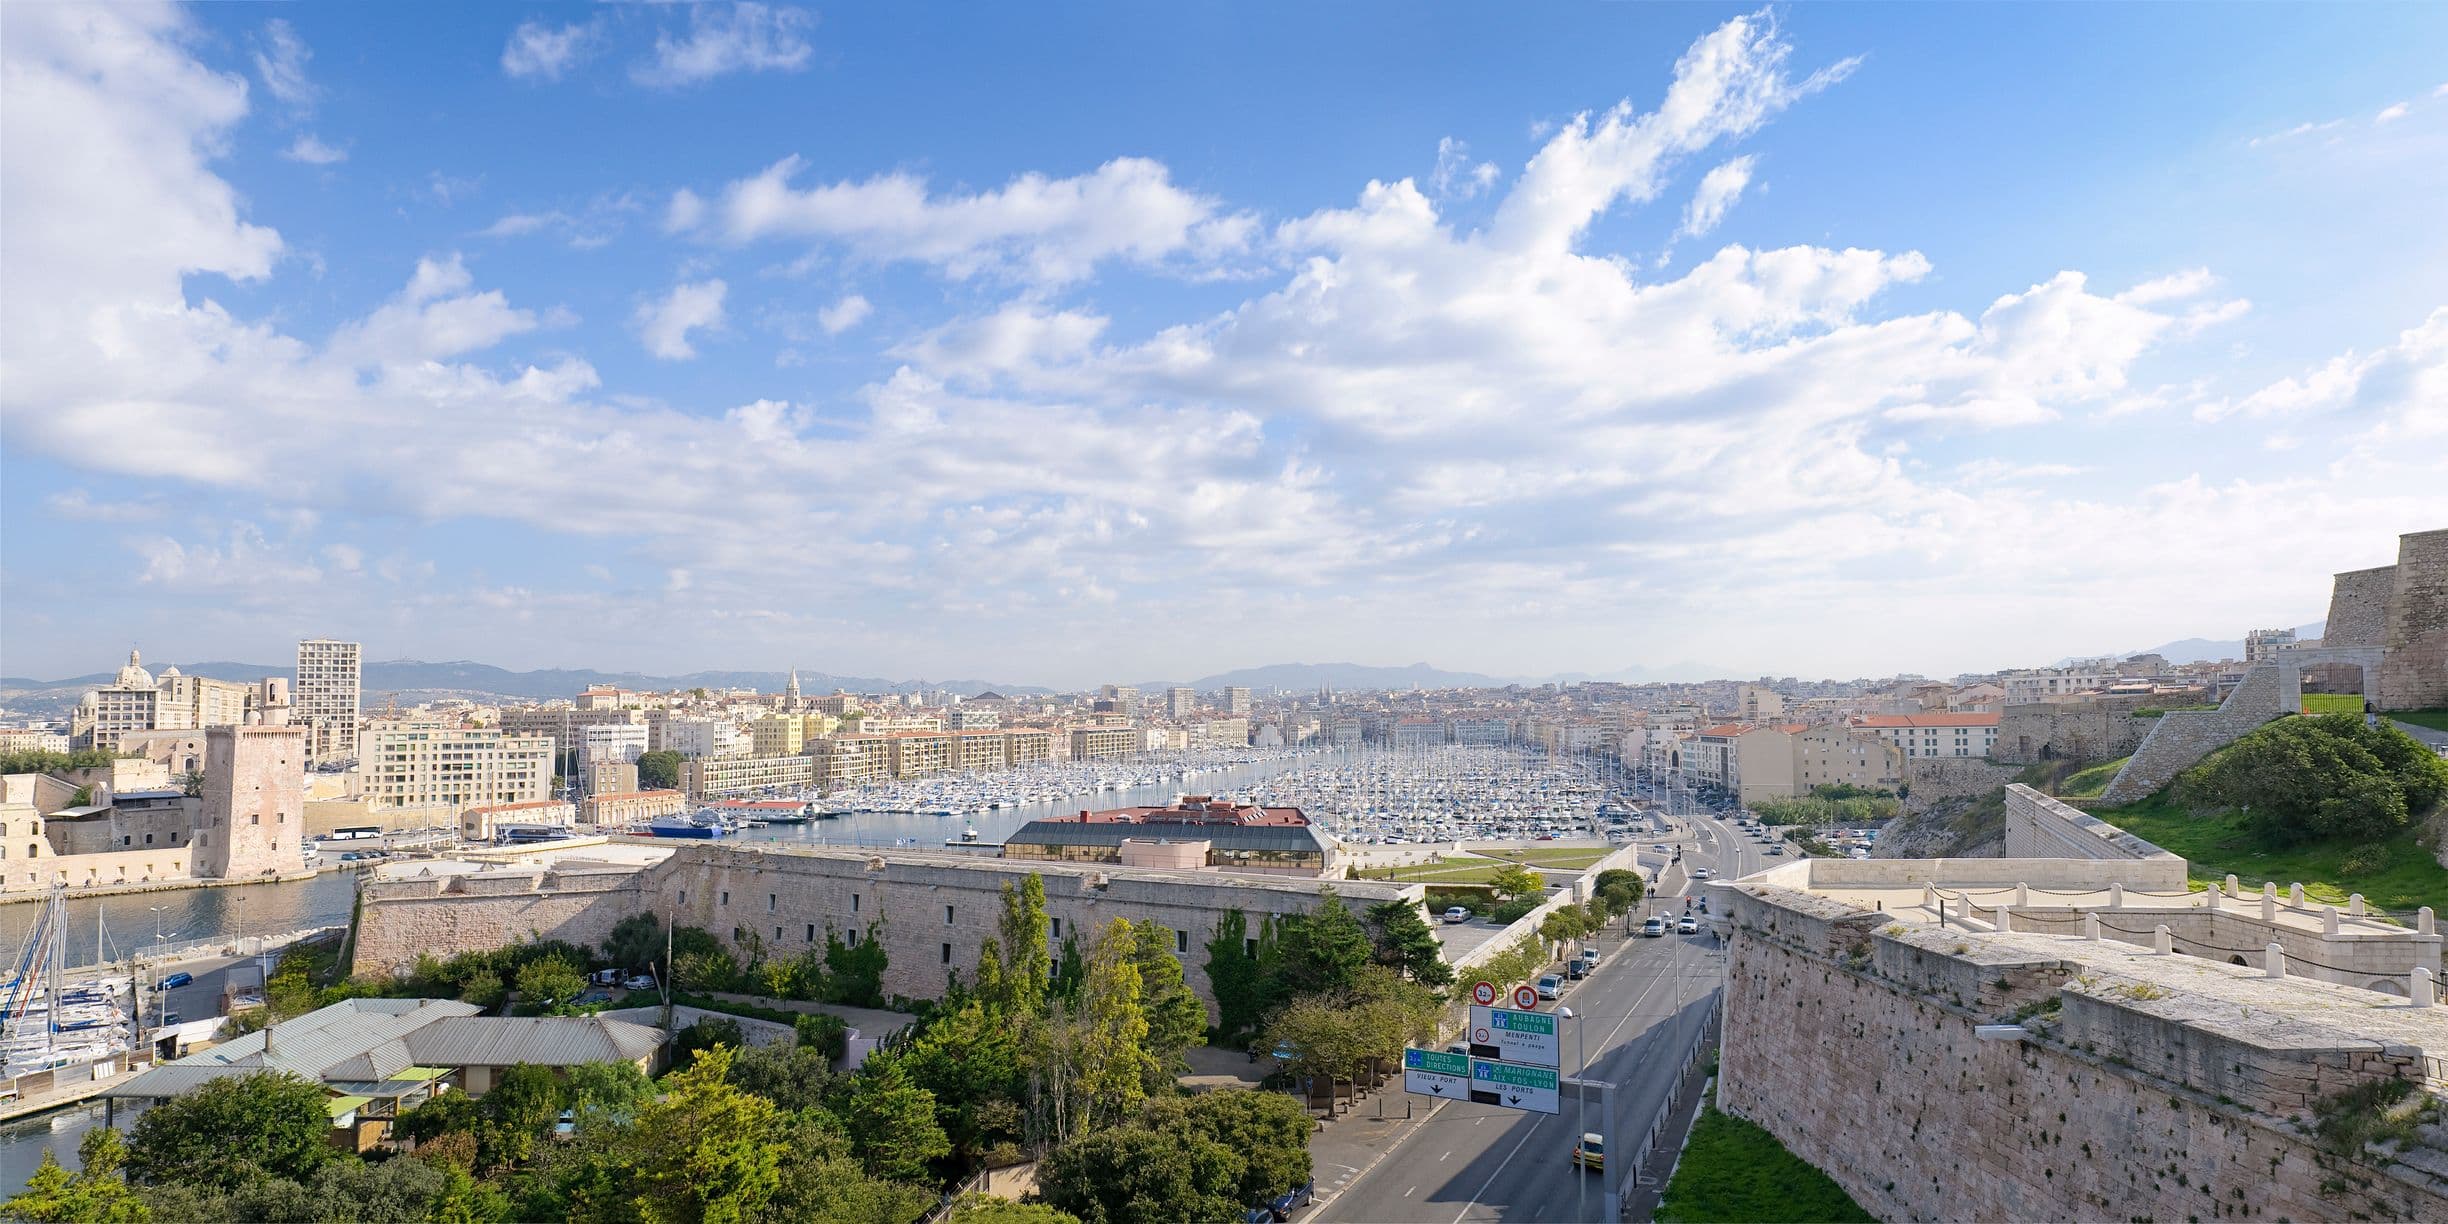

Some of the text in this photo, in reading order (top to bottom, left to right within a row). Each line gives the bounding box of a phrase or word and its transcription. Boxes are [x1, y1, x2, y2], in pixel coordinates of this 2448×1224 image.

[1512, 1014, 1552, 1025] AUBAGNE
[1512, 1022, 1545, 1033] TOULON
[1505, 1031, 1540, 1041] MENPENTI
[1427, 1053, 1452, 1063] TOUTES
[1426, 1061, 1466, 1073] DIRECTIONS
[1416, 1072, 1457, 1084] VIEUX PORT
[1503, 1066, 1554, 1080] MARIGNANE
[1495, 1083, 1534, 1094] LES PORTS
